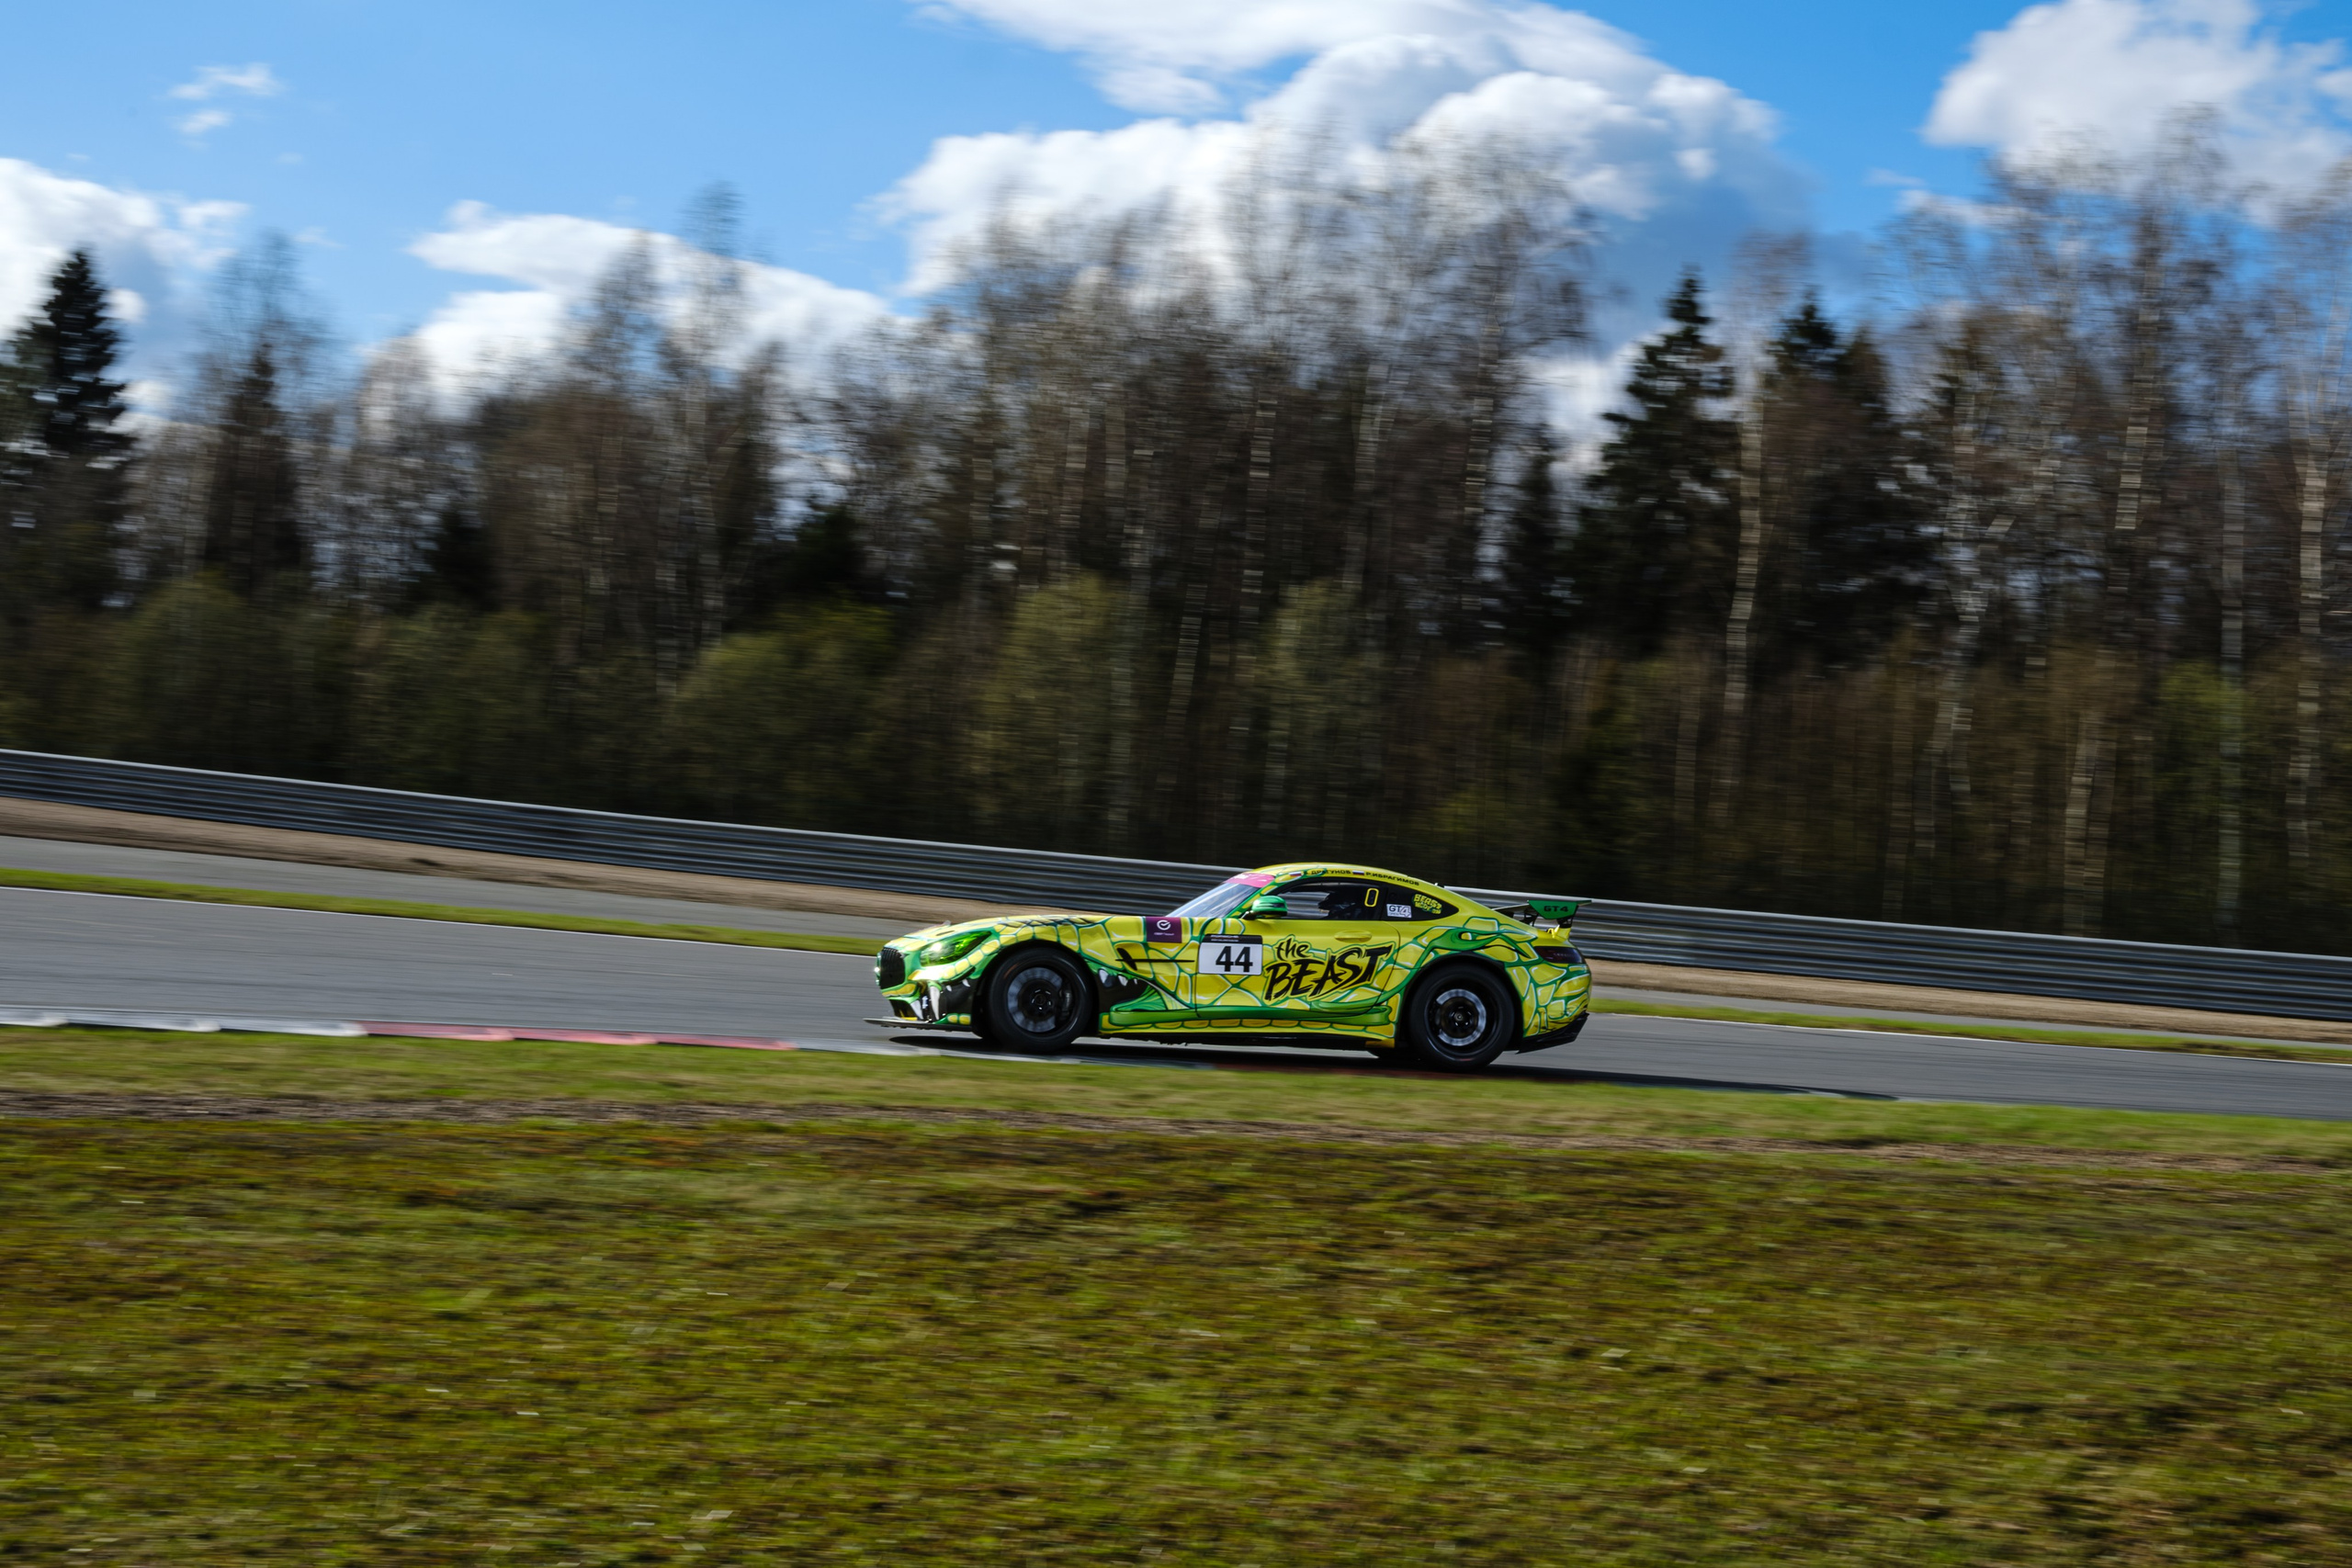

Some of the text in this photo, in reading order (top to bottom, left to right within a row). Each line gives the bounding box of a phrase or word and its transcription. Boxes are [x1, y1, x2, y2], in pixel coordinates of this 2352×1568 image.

[1388, 905, 1411, 918] GT4
[1216, 945, 1253, 973] 44
[1275, 938, 1310, 962] the
[1265, 944, 1393, 1001] BEAST
